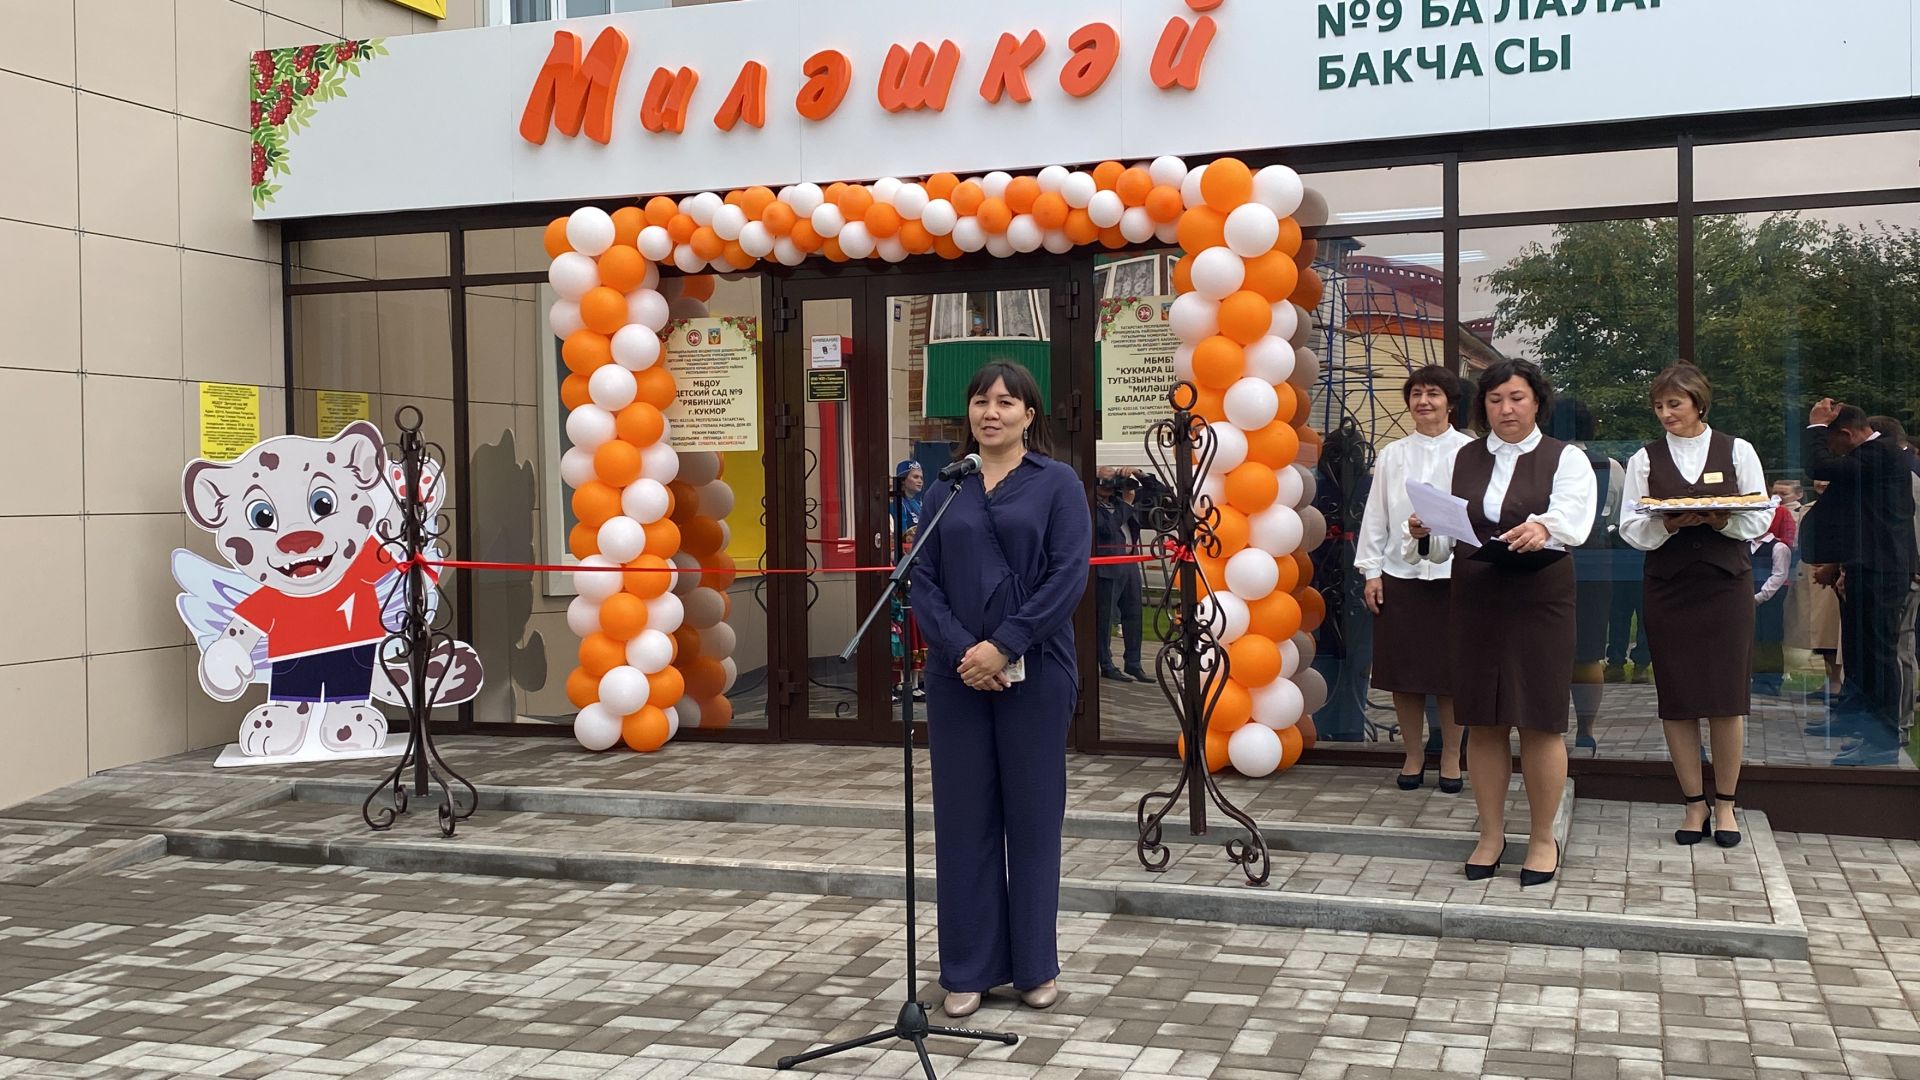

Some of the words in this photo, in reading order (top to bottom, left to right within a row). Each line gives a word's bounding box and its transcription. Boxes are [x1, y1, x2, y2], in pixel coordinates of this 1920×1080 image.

[1318, 0, 1402, 38] №9
[1116, 366, 1163, 374] "КУКМАРА
[1107, 376, 1165, 384] ТУГЫЗЫНЧЫ
[676, 387, 710, 398] ДЕТСКИЙ
